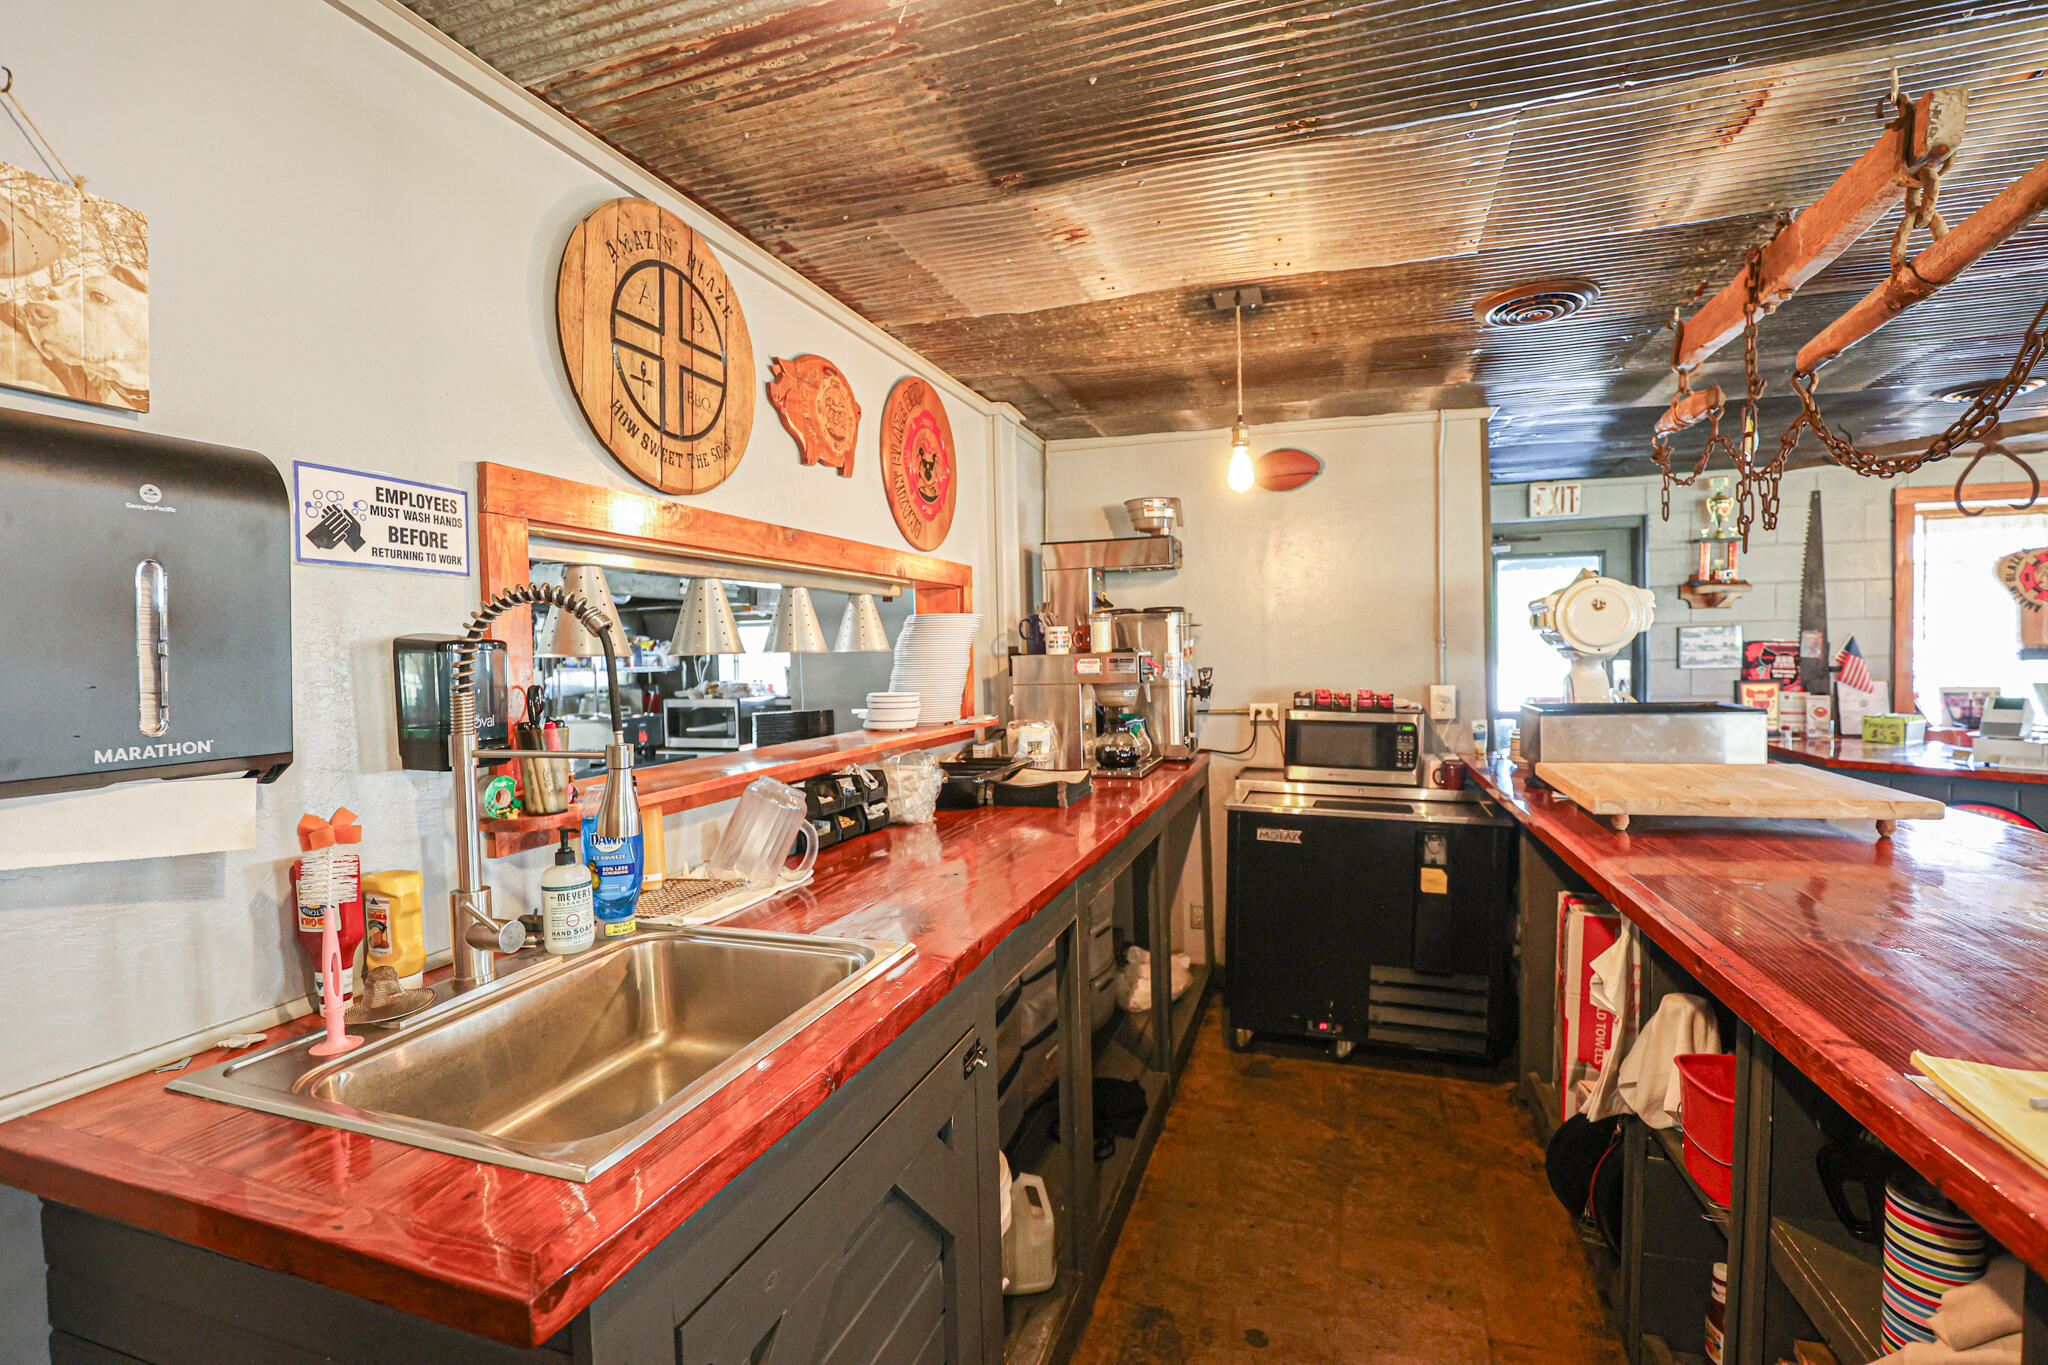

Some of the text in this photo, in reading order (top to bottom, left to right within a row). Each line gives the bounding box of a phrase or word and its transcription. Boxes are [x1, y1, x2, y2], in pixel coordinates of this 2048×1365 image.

[639, 282, 655, 311] A
[687, 249, 733, 318] BLAZE
[610, 399, 640, 439] HOW
[640, 433, 683, 468] SWEET
[687, 452, 710, 469] THE
[375, 486, 458, 514] EMPLOYEES
[1535, 485, 1579, 515] EXIT
[370, 504, 463, 529] MUST WASH HANDS
[388, 525, 448, 550] BEFORE
[371, 547, 463, 566] RETURNING TO WORK
[94, 741, 212, 764] MARATHON
[590, 834, 627, 846] DAWN
[557, 888, 591, 903] MEYER'S
[1594, 1023, 1607, 1065] TOWELS
